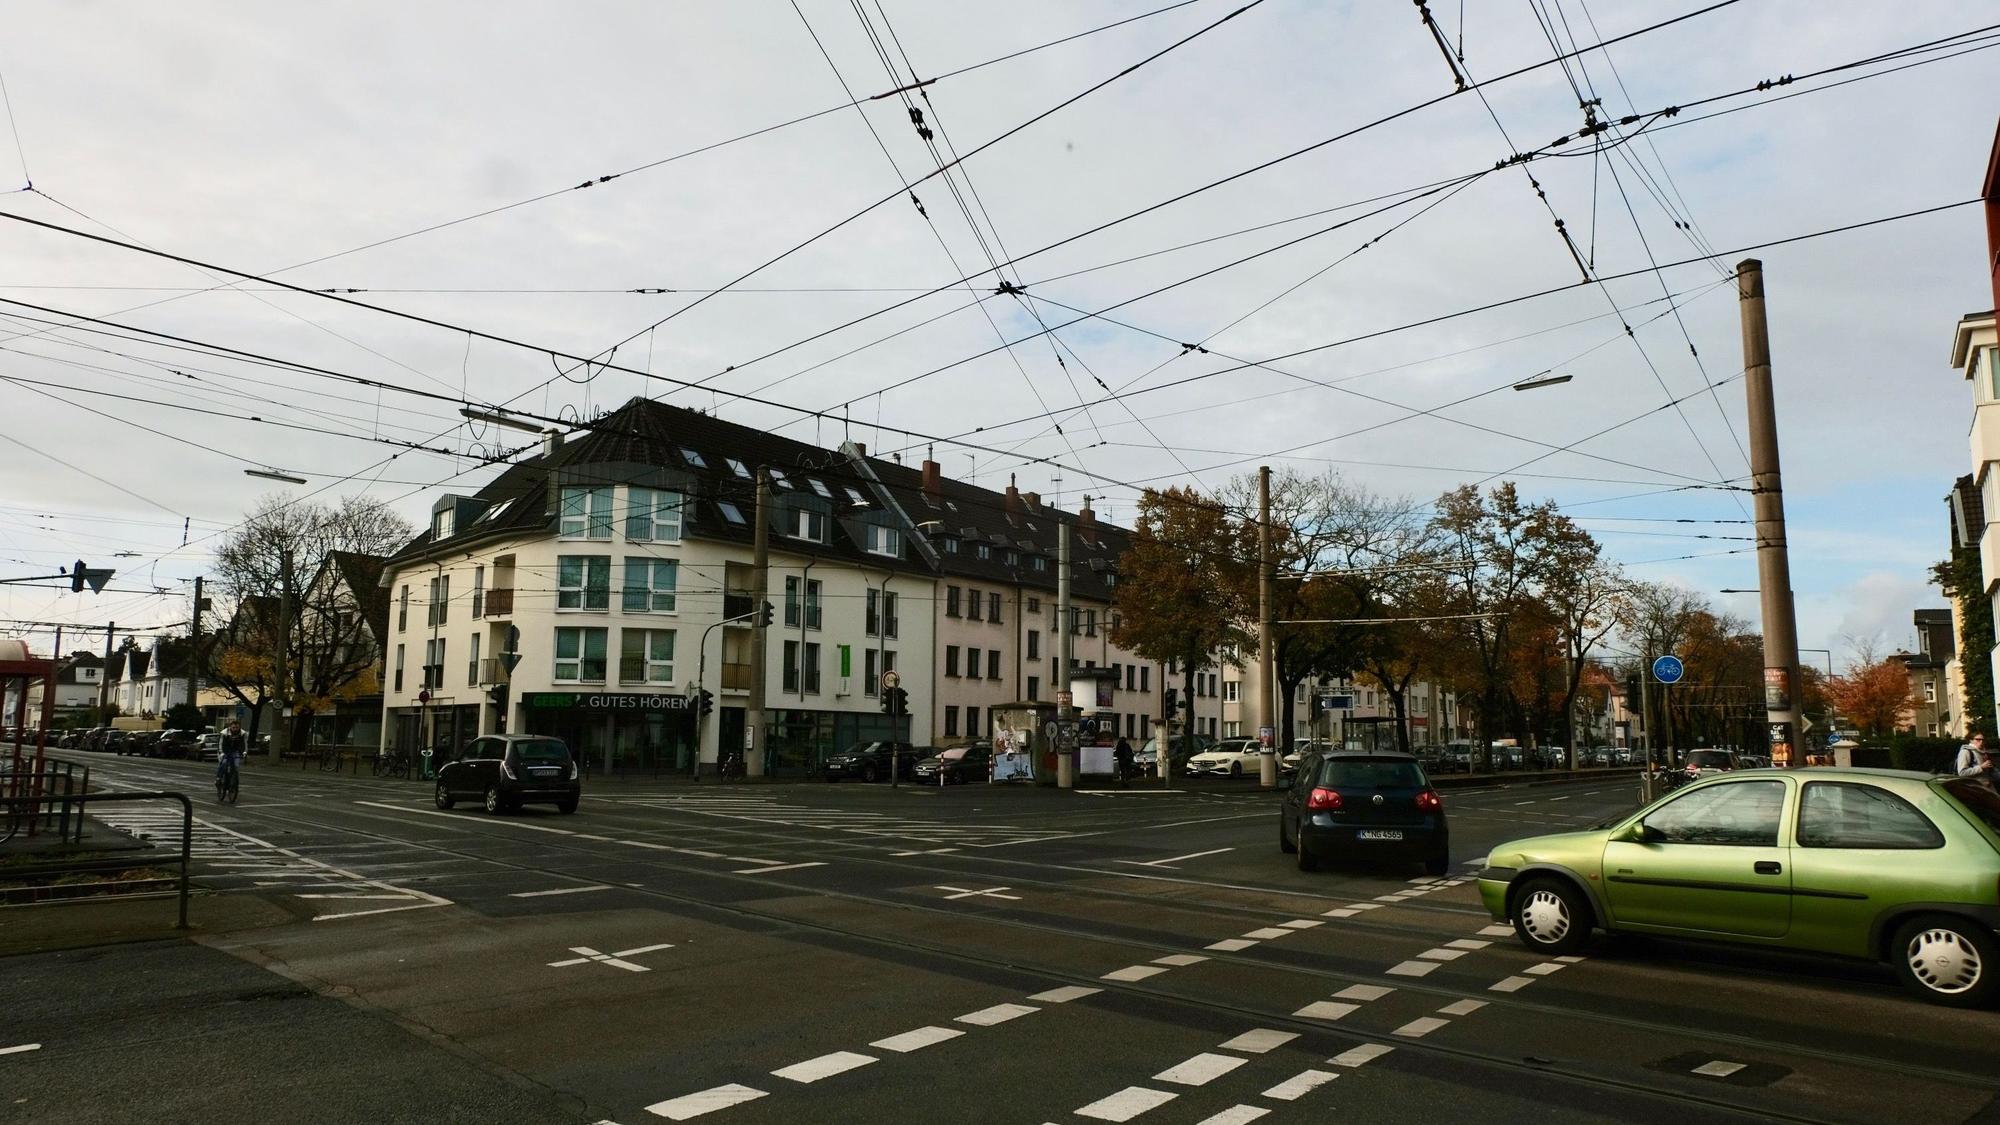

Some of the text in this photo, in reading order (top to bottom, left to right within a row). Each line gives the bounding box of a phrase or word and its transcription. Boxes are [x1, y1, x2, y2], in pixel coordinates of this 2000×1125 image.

[533, 694, 690, 710] GEERS GUTES HÖREN
